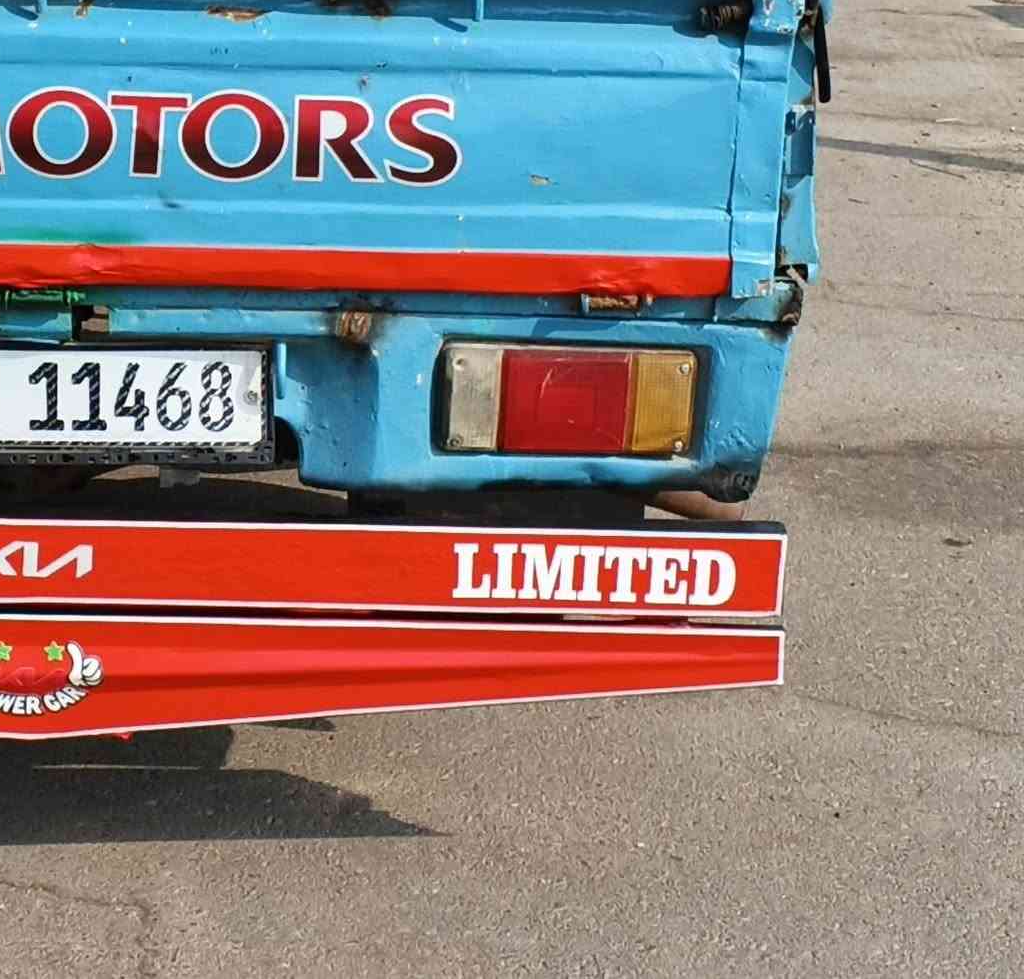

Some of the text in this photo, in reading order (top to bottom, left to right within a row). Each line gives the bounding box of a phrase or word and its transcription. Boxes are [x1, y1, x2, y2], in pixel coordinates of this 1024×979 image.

[28, 361, 235, 432] 11468
[452, 542, 737, 606] LIMITED
[43, 684, 87, 713] CAR
